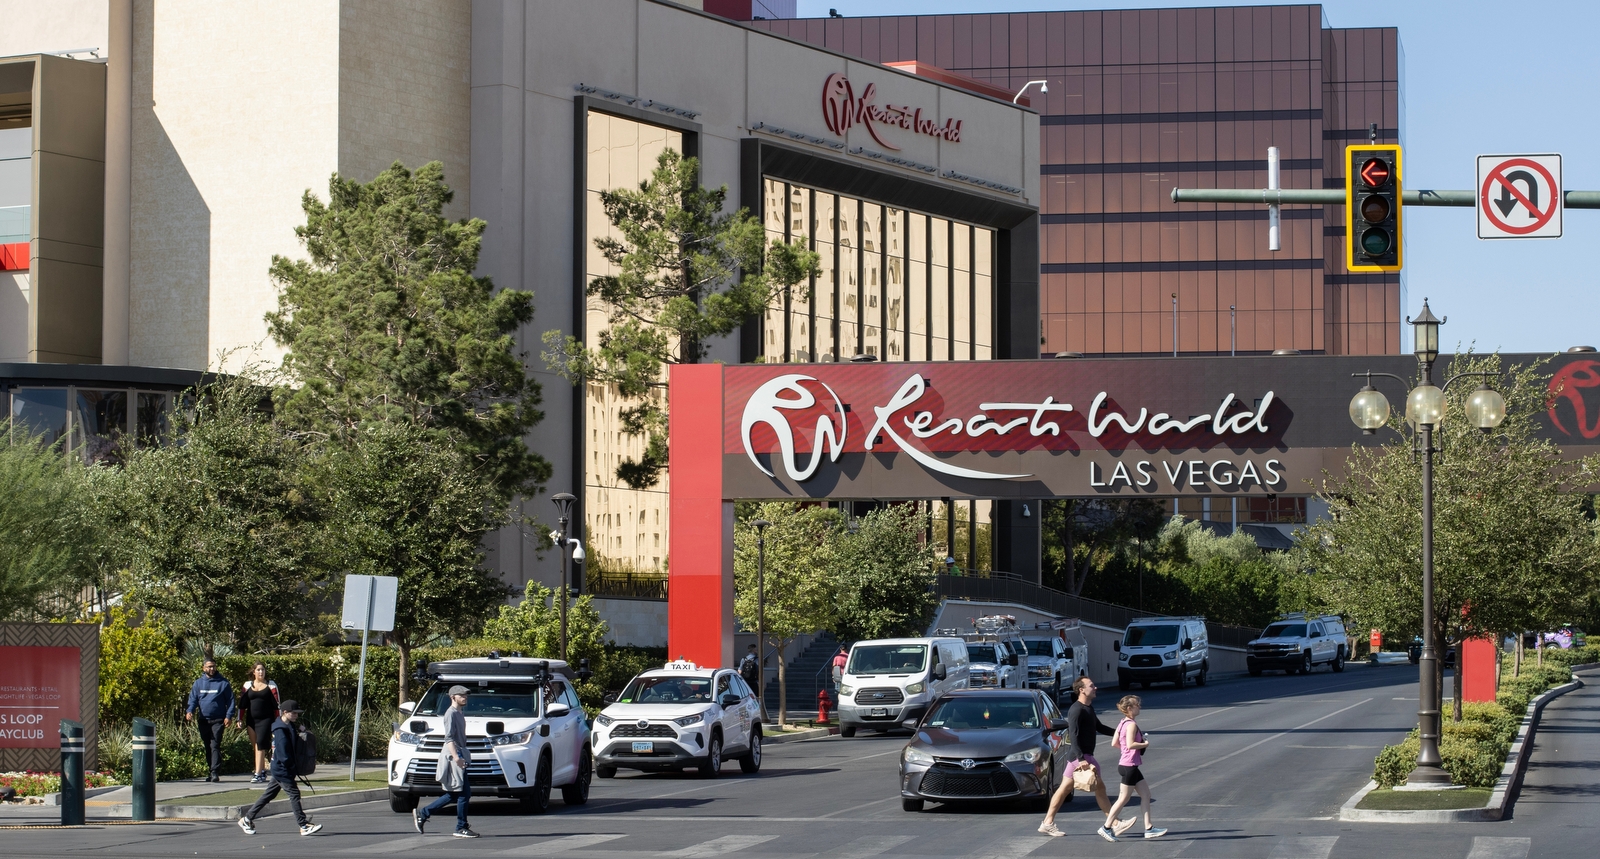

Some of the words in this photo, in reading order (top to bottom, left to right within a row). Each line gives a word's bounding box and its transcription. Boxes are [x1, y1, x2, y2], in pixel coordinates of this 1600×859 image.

[1087, 390, 1275, 438] World
[1090, 460, 1152, 487] LAS
[1162, 459, 1281, 486] VEGAS
[10, 714, 43, 724] LOOP
